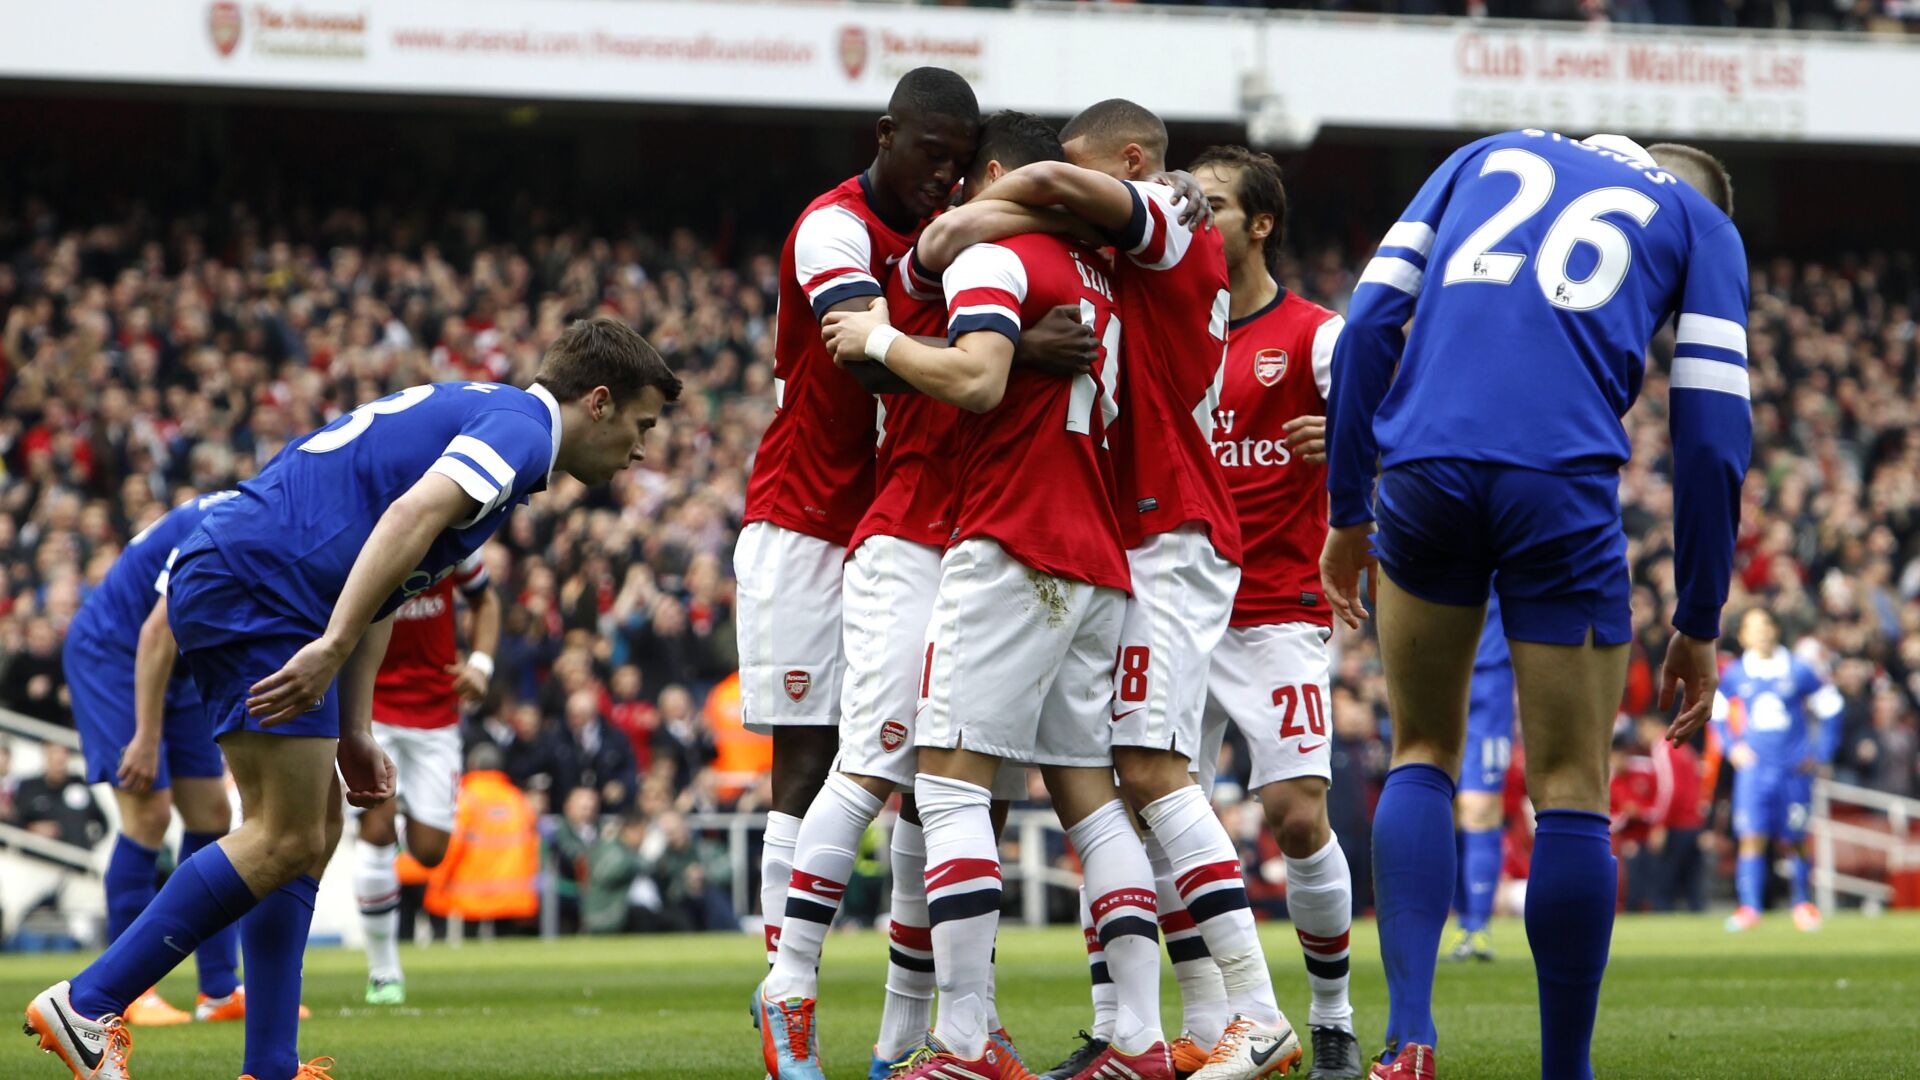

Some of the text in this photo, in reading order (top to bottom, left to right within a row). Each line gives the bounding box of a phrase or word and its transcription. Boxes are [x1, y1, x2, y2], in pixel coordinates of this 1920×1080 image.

[1457, 33, 1807, 96] Club Level Waiting List
[1443, 148, 1660, 312] 26
[297, 383, 435, 453] 3
[1210, 436, 1292, 467] rates
[919, 642, 935, 698] 1
[1272, 683, 1326, 739] 20
[1099, 894, 1156, 911] ARSEN
